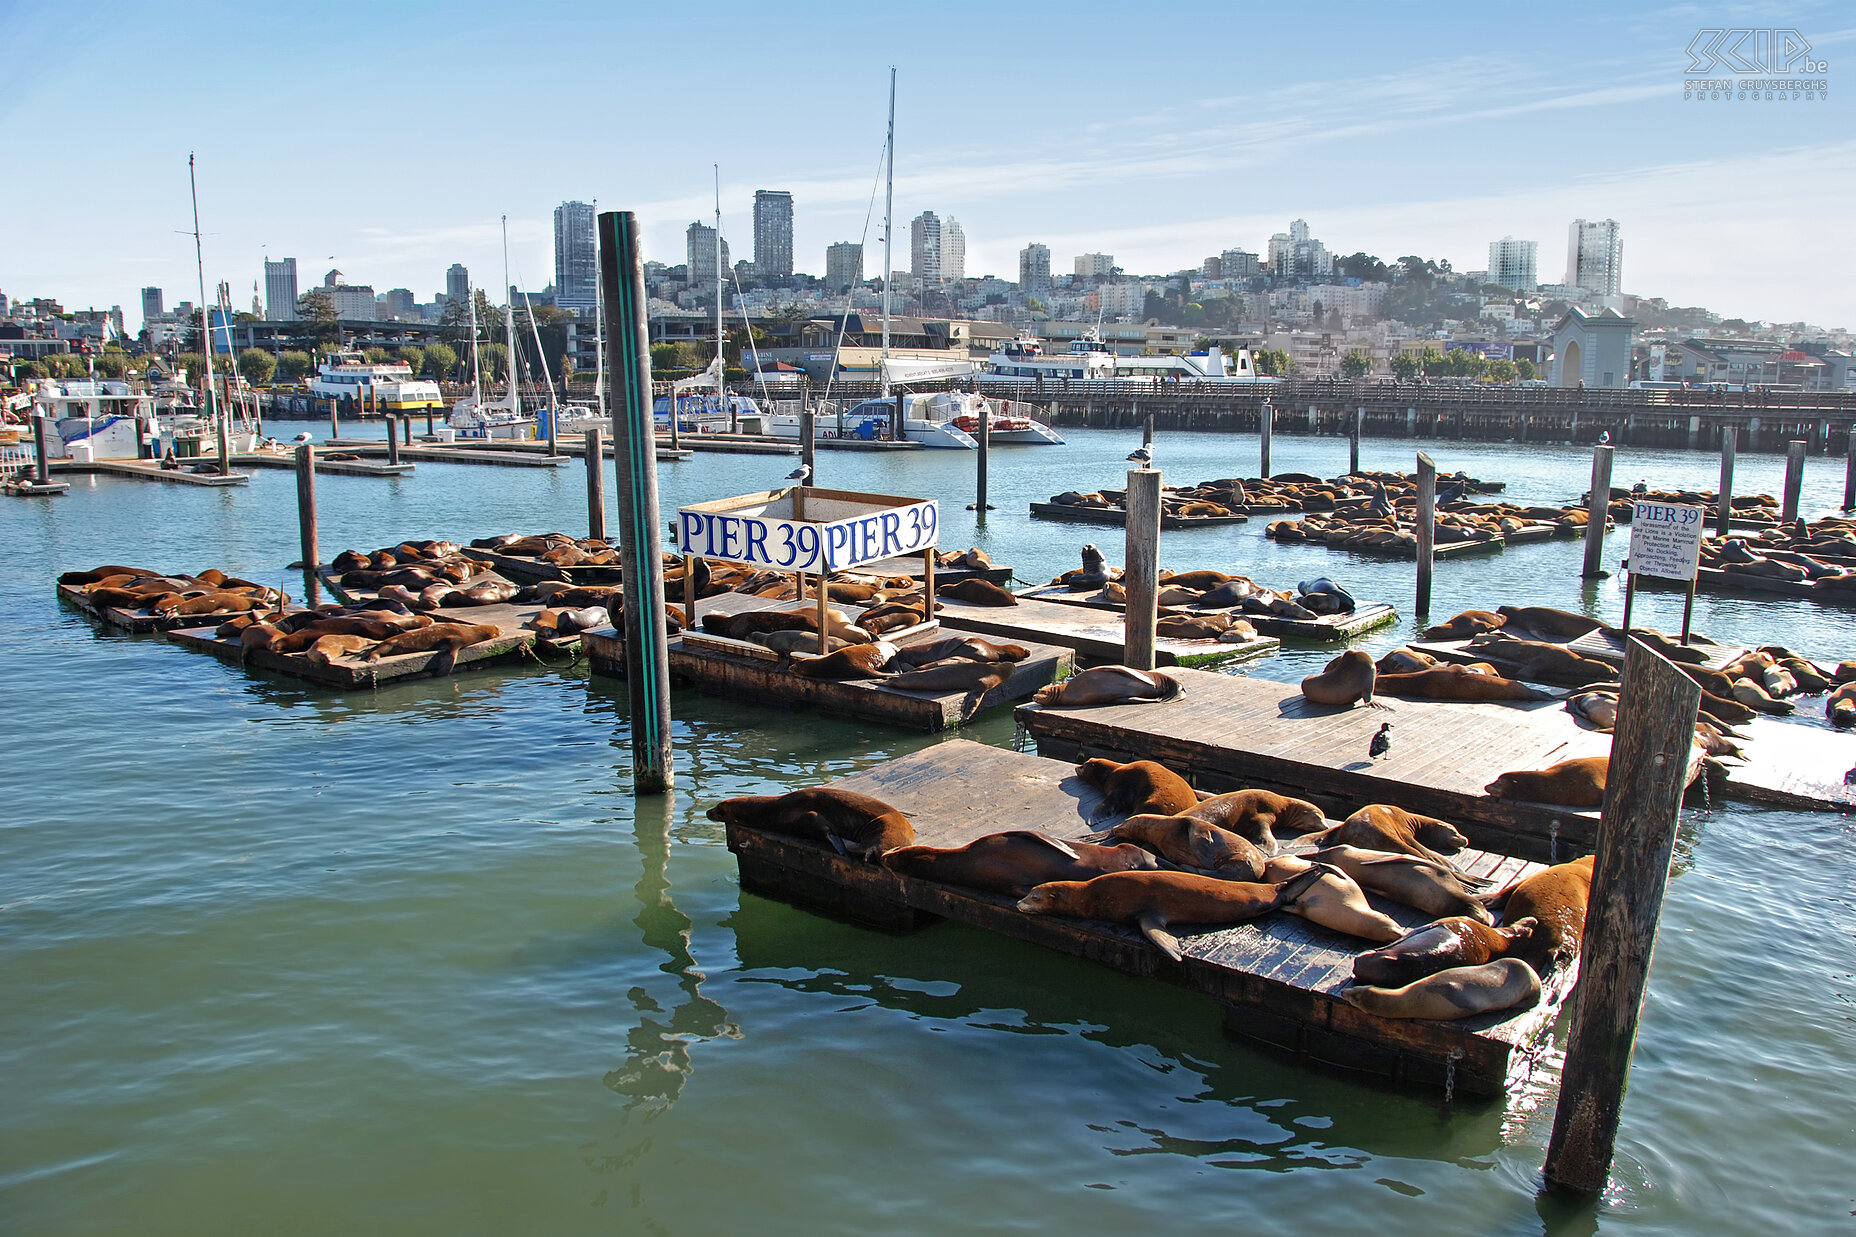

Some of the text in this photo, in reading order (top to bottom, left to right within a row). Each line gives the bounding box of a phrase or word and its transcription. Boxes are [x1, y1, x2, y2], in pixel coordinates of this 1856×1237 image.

[1635, 504, 1698, 524] PIER 39
[1640, 522, 1671, 530] Harassment
[679, 511, 820, 569] PIER 39
[824, 503, 938, 569] PIER 39
[1639, 565, 1658, 573] Objects
[1654, 560, 1677, 568] Throwing
